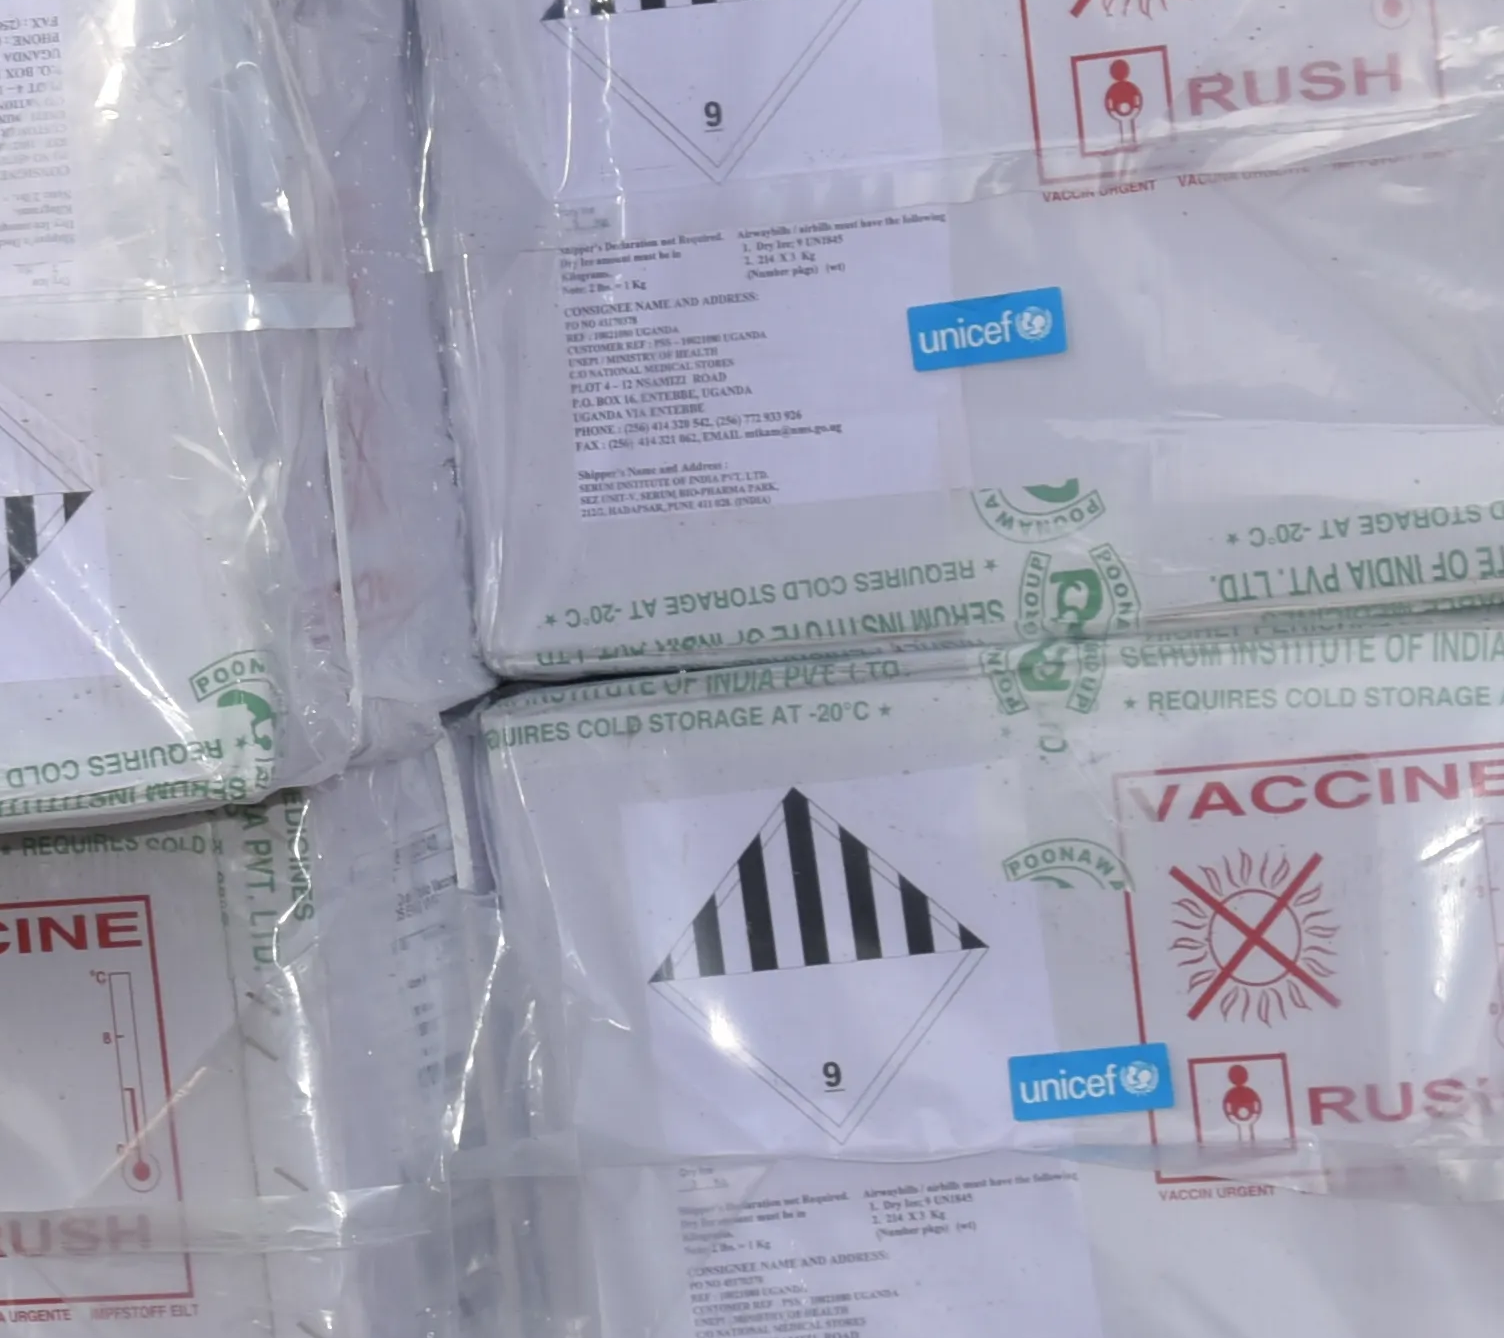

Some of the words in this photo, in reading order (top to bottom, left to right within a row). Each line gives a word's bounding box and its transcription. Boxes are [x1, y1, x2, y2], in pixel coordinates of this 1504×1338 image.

[1187, 55, 1408, 116] RUSH
[702, 100, 724, 128] 9
[834, 219, 857, 233] must
[860, 217, 882, 231] have
[885, 216, 900, 229] the
[903, 212, 945, 227] following
[564, 303, 632, 318] CONSIGNEE
[636, 300, 672, 312] NAME
[674, 297, 699, 309] AND
[702, 292, 759, 306] ADDRESS:
[919, 313, 1014, 357] unicef
[589, 366, 641, 378] NATIONAL
[644, 362, 692, 374] MEDICAL
[695, 359, 734, 370] STORES
[606, 352, 656, 365] MINISTRY
[659, 351, 673, 361] OF
[676, 347, 718, 359] HEALTH
[571, 382, 602, 393] PLOT
[622, 379, 632, 390] 12
[693, 372, 726, 384] ROAD
[596, 395, 621, 407] BOX
[642, 390, 698, 404] ENTEBBE,
[702, 385, 752, 399] UGANDA
[574, 409, 624, 423] UGANDA
[626, 408, 646, 419] VIA
[649, 403, 704, 417] ENTEBBE
[1386, 635, 1422, 666] OF
[1148, 689, 1278, 711] REQUIRES
[1285, 688, 1355, 709] COLD
[1365, 686, 1490, 709] STORAGE
[822, 1060, 844, 1090] 9
[1020, 1062, 1116, 1104] unicef
[11, 1309, 71, 1322] URGENTE
